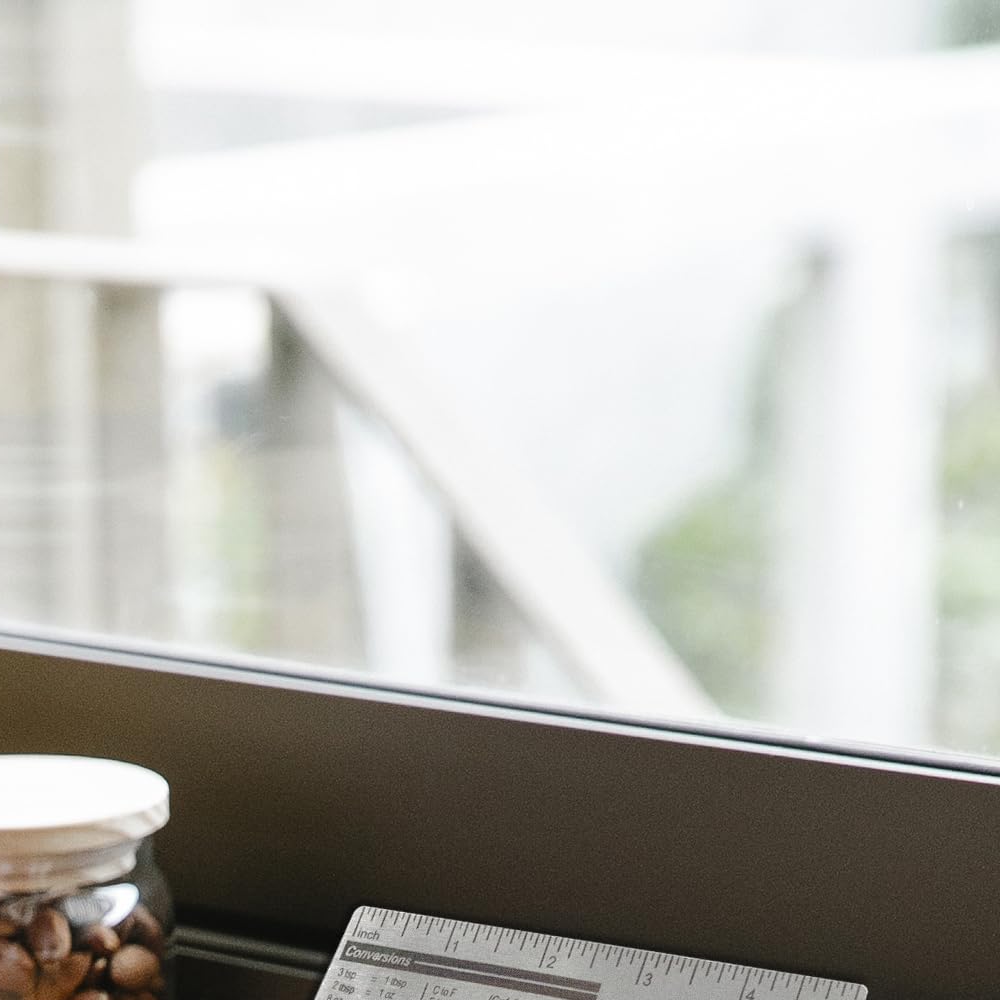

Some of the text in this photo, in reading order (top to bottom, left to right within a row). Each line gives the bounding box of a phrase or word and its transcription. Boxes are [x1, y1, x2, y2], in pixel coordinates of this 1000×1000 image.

[345, 944, 412, 966] Conversions
[357, 930, 380, 941] inch
[546, 956, 557, 969] 2
[643, 973, 653, 986] 3
[386, 976, 390, 984] 1
[331, 981, 339, 990] 2
[380, 989, 384, 997] 1
[433, 985, 458, 997] C to F
